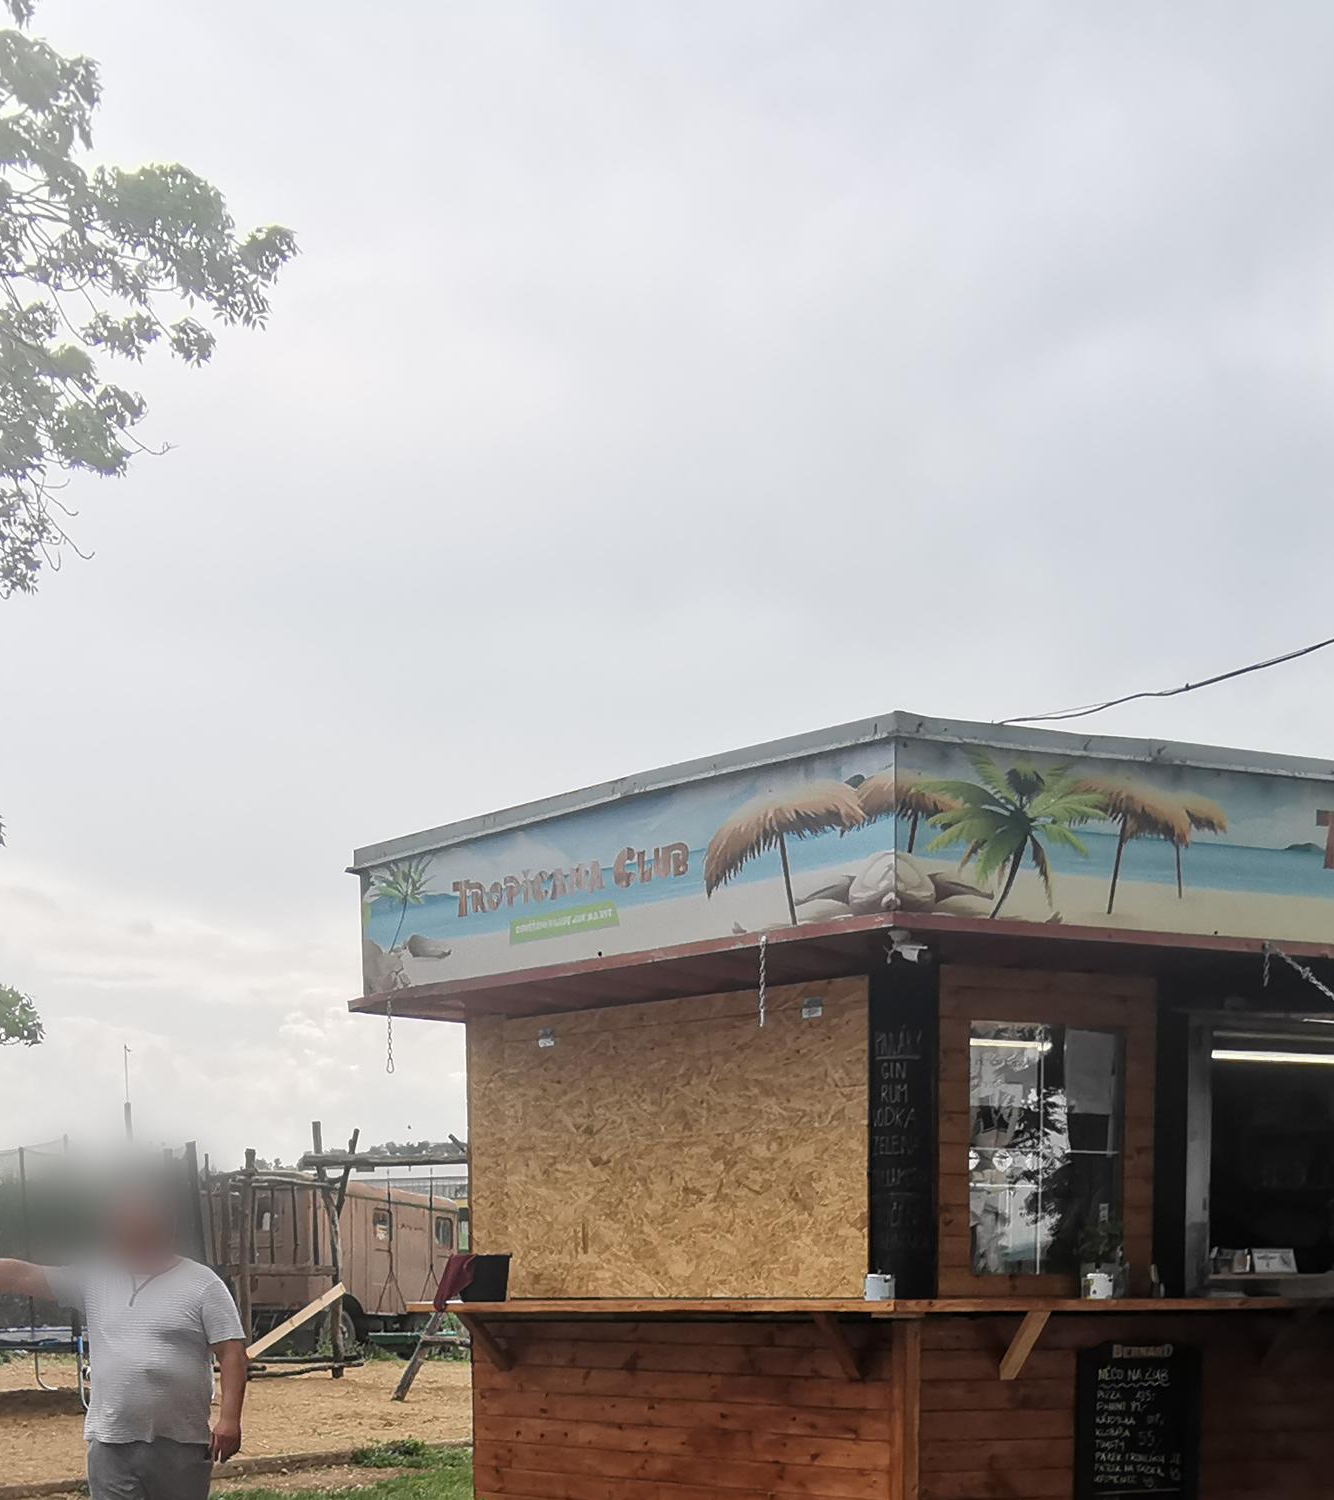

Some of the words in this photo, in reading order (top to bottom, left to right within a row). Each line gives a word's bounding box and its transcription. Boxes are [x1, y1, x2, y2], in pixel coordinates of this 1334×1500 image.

[452, 860, 605, 918] TROPICANA
[613, 842, 690, 889] CLUB
[881, 1061, 907, 1080] GIN
[881, 1084, 908, 1104] RUM
[1112, 1344, 1173, 1359] BERNARD
